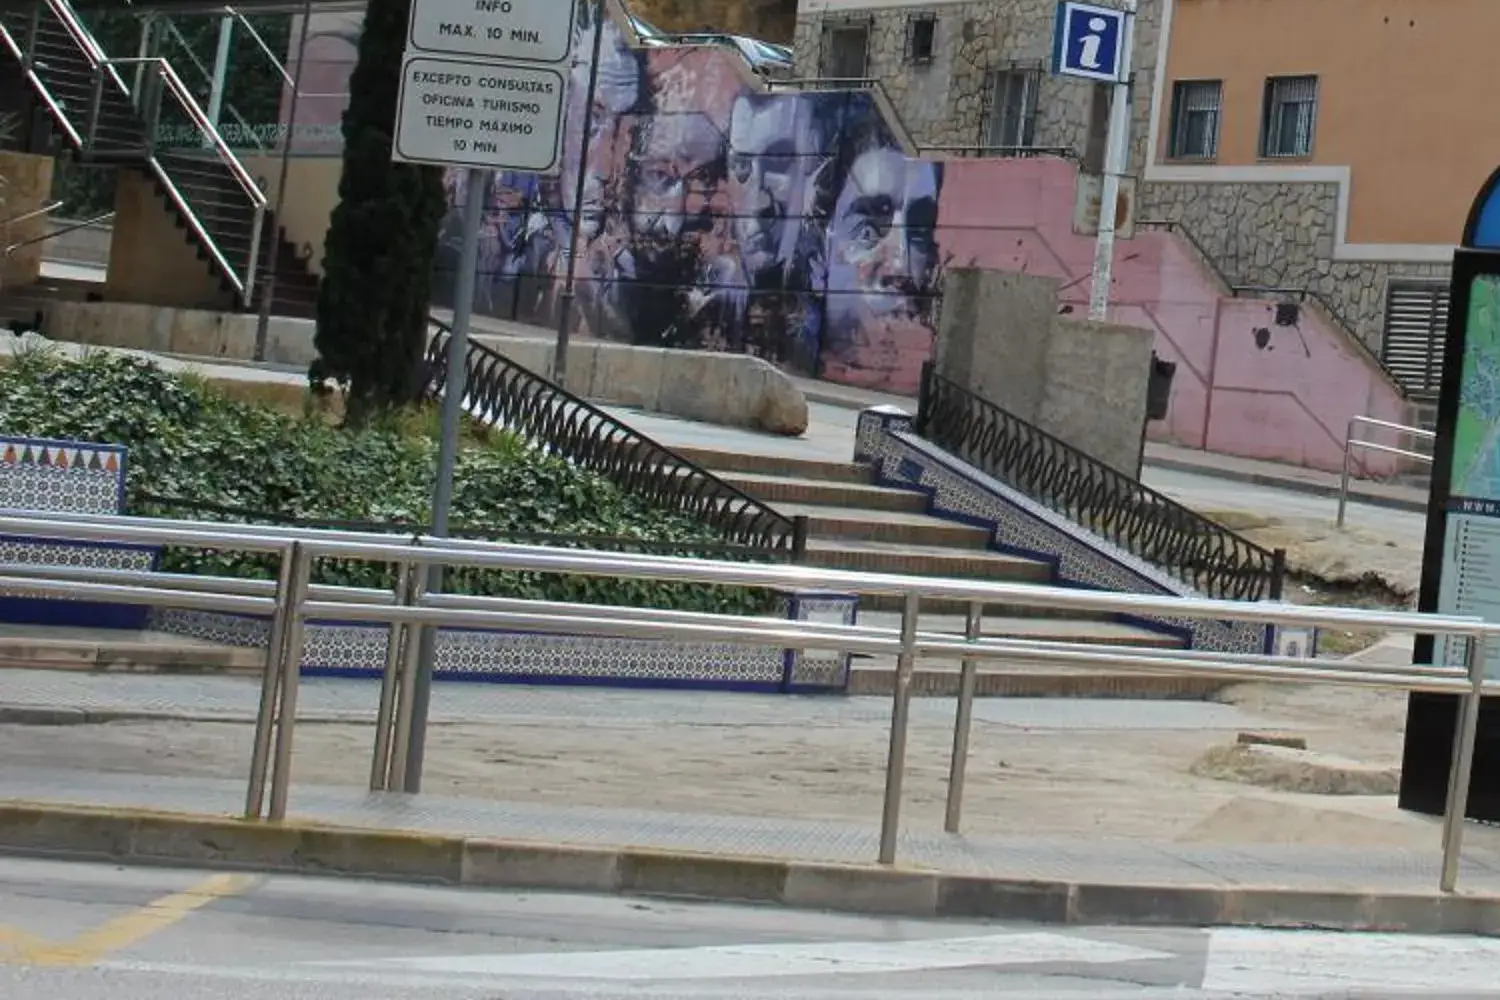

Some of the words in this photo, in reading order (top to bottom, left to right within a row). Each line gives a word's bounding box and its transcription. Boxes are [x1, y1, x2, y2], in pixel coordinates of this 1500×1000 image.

[475, 0, 512, 13] INFO
[439, 22, 476, 38] MAX.
[486, 27, 503, 40] 10
[413, 71, 472, 87] EXCEPTO
[478, 77, 554, 94] CONSULTAS
[421, 93, 475, 109] OFICINA
[483, 98, 541, 115] TURISMO
[425, 115, 474, 130] TIEMPO
[479, 119, 533, 135] MAXIMO
[452, 139, 467, 151] 10
